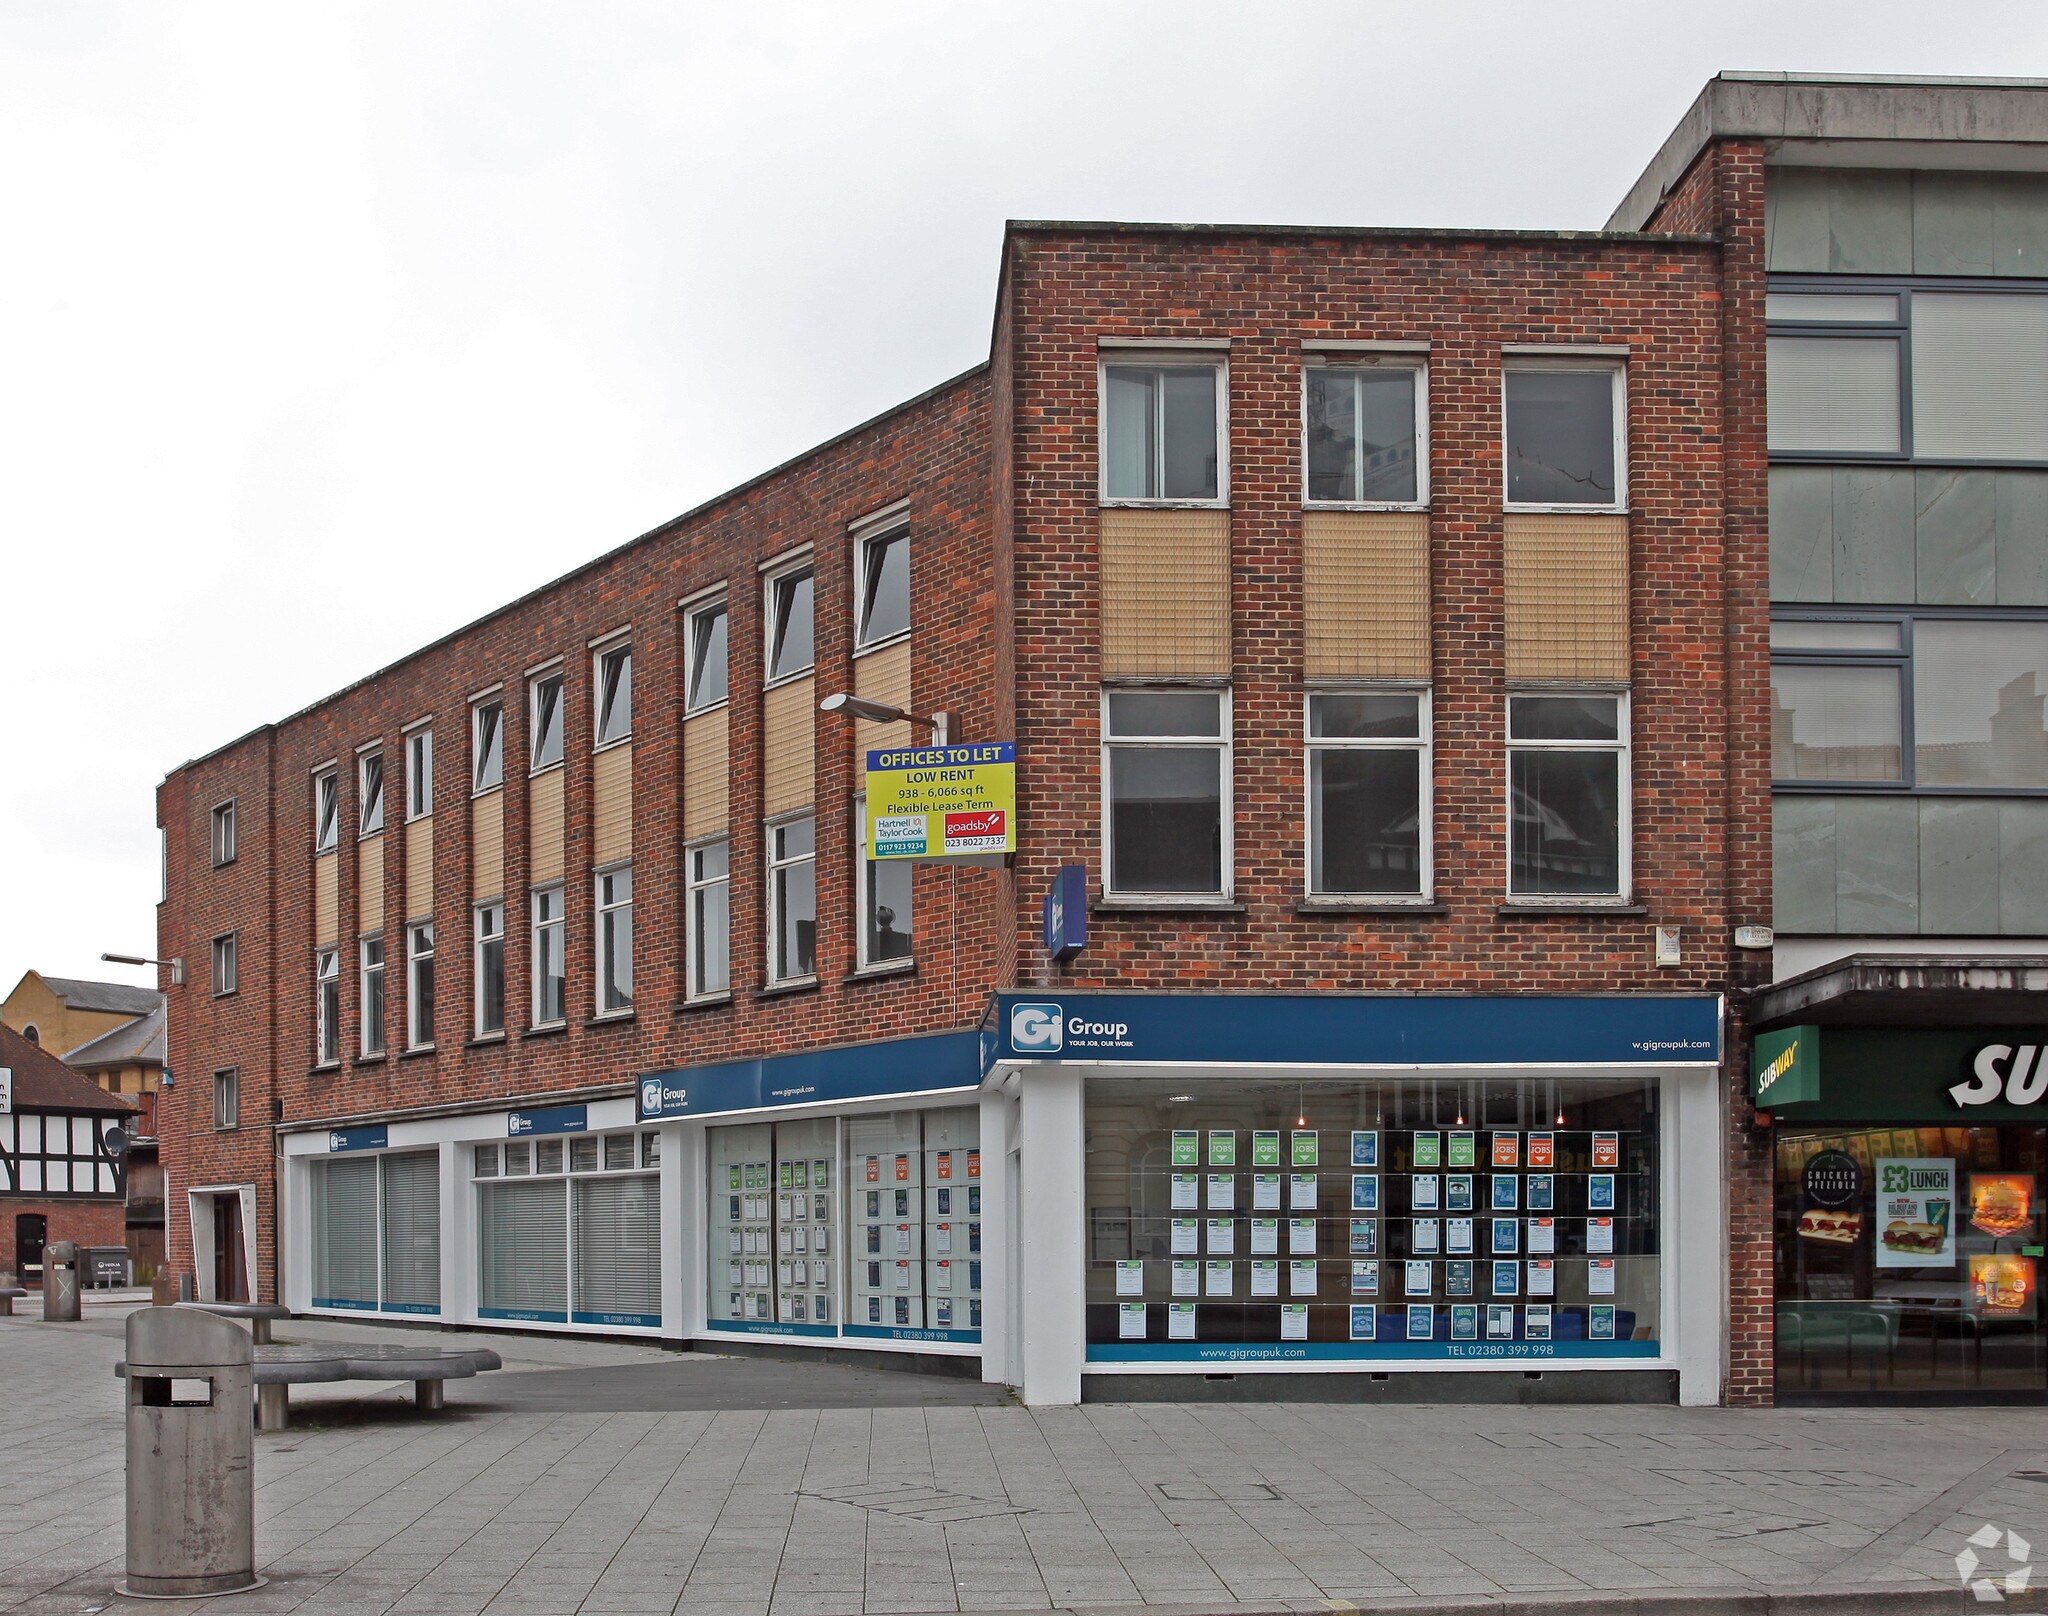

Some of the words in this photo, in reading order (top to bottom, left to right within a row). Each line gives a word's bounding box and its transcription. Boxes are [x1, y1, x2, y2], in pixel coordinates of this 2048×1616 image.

[879, 751, 945, 767] OFFICES
[947, 749, 970, 763] TO
[973, 747, 1002, 761] LET
[906, 772, 937, 783] LOW
[940, 769, 975, 781] RENT
[898, 789, 919, 799] 938
[928, 787, 958, 798] 6,066
[960, 788, 973, 797] sq
[975, 784, 984, 794] ft
[887, 802, 930, 814] Flexible
[932, 802, 964, 811] Lease
[966, 800, 993, 809] Term
[878, 819, 911, 828] Hartnell
[947, 819, 991, 835] goadsby
[878, 829, 902, 838] Taylor
[902, 828, 923, 836] Cook
[907, 842, 924, 850] 9234
[945, 839, 961, 847] 023
[962, 837, 983, 846] 8022
[985, 836, 1006, 845] 7337
[1012, 1009, 1062, 1046] Gi
[1068, 1017, 1128, 1040] Group
[1632, 1038, 1711, 1051] w.gigroupuk.com
[1758, 1040, 1798, 1095] SUBWAY
[1948, 1044, 2048, 1108] SU
[771, 1085, 815, 1097] www.gigroupuk.com
[643, 1084, 662, 1109] Gi
[663, 1087, 686, 1102] Group
[1175, 1145, 1196, 1153] JOBS
[1211, 1145, 1233, 1153] JOBS
[1256, 1145, 1277, 1153] JOBS
[1294, 1145, 1315, 1153] JOBS
[1416, 1145, 1437, 1153] JOBS
[1451, 1145, 1472, 1153] JOBS
[1495, 1146, 1516, 1154] JOBS
[1530, 1146, 1551, 1154] JOBS
[1594, 1146, 1616, 1154] JOBS
[1808, 1171, 1856, 1180] CHICKEN
[1882, 1165, 1909, 1193] £3
[1910, 1172, 1949, 1188] LUNCH
[1808, 1181, 1856, 1190] PIZZIOLA
[748, 1325, 794, 1334] www.gigroupuk.com
[892, 1330, 902, 1338] TEL
[903, 1331, 922, 1340] 02380
[923, 1331, 935, 1340] 399
[936, 1332, 948, 1340] 998
[1200, 1347, 1306, 1360] www.gigroupuk.com
[1447, 1345, 1465, 1355] TEL
[1468, 1345, 1504, 1355] 02380
[1507, 1345, 1529, 1355] 399
[1532, 1345, 1554, 1355] 998
